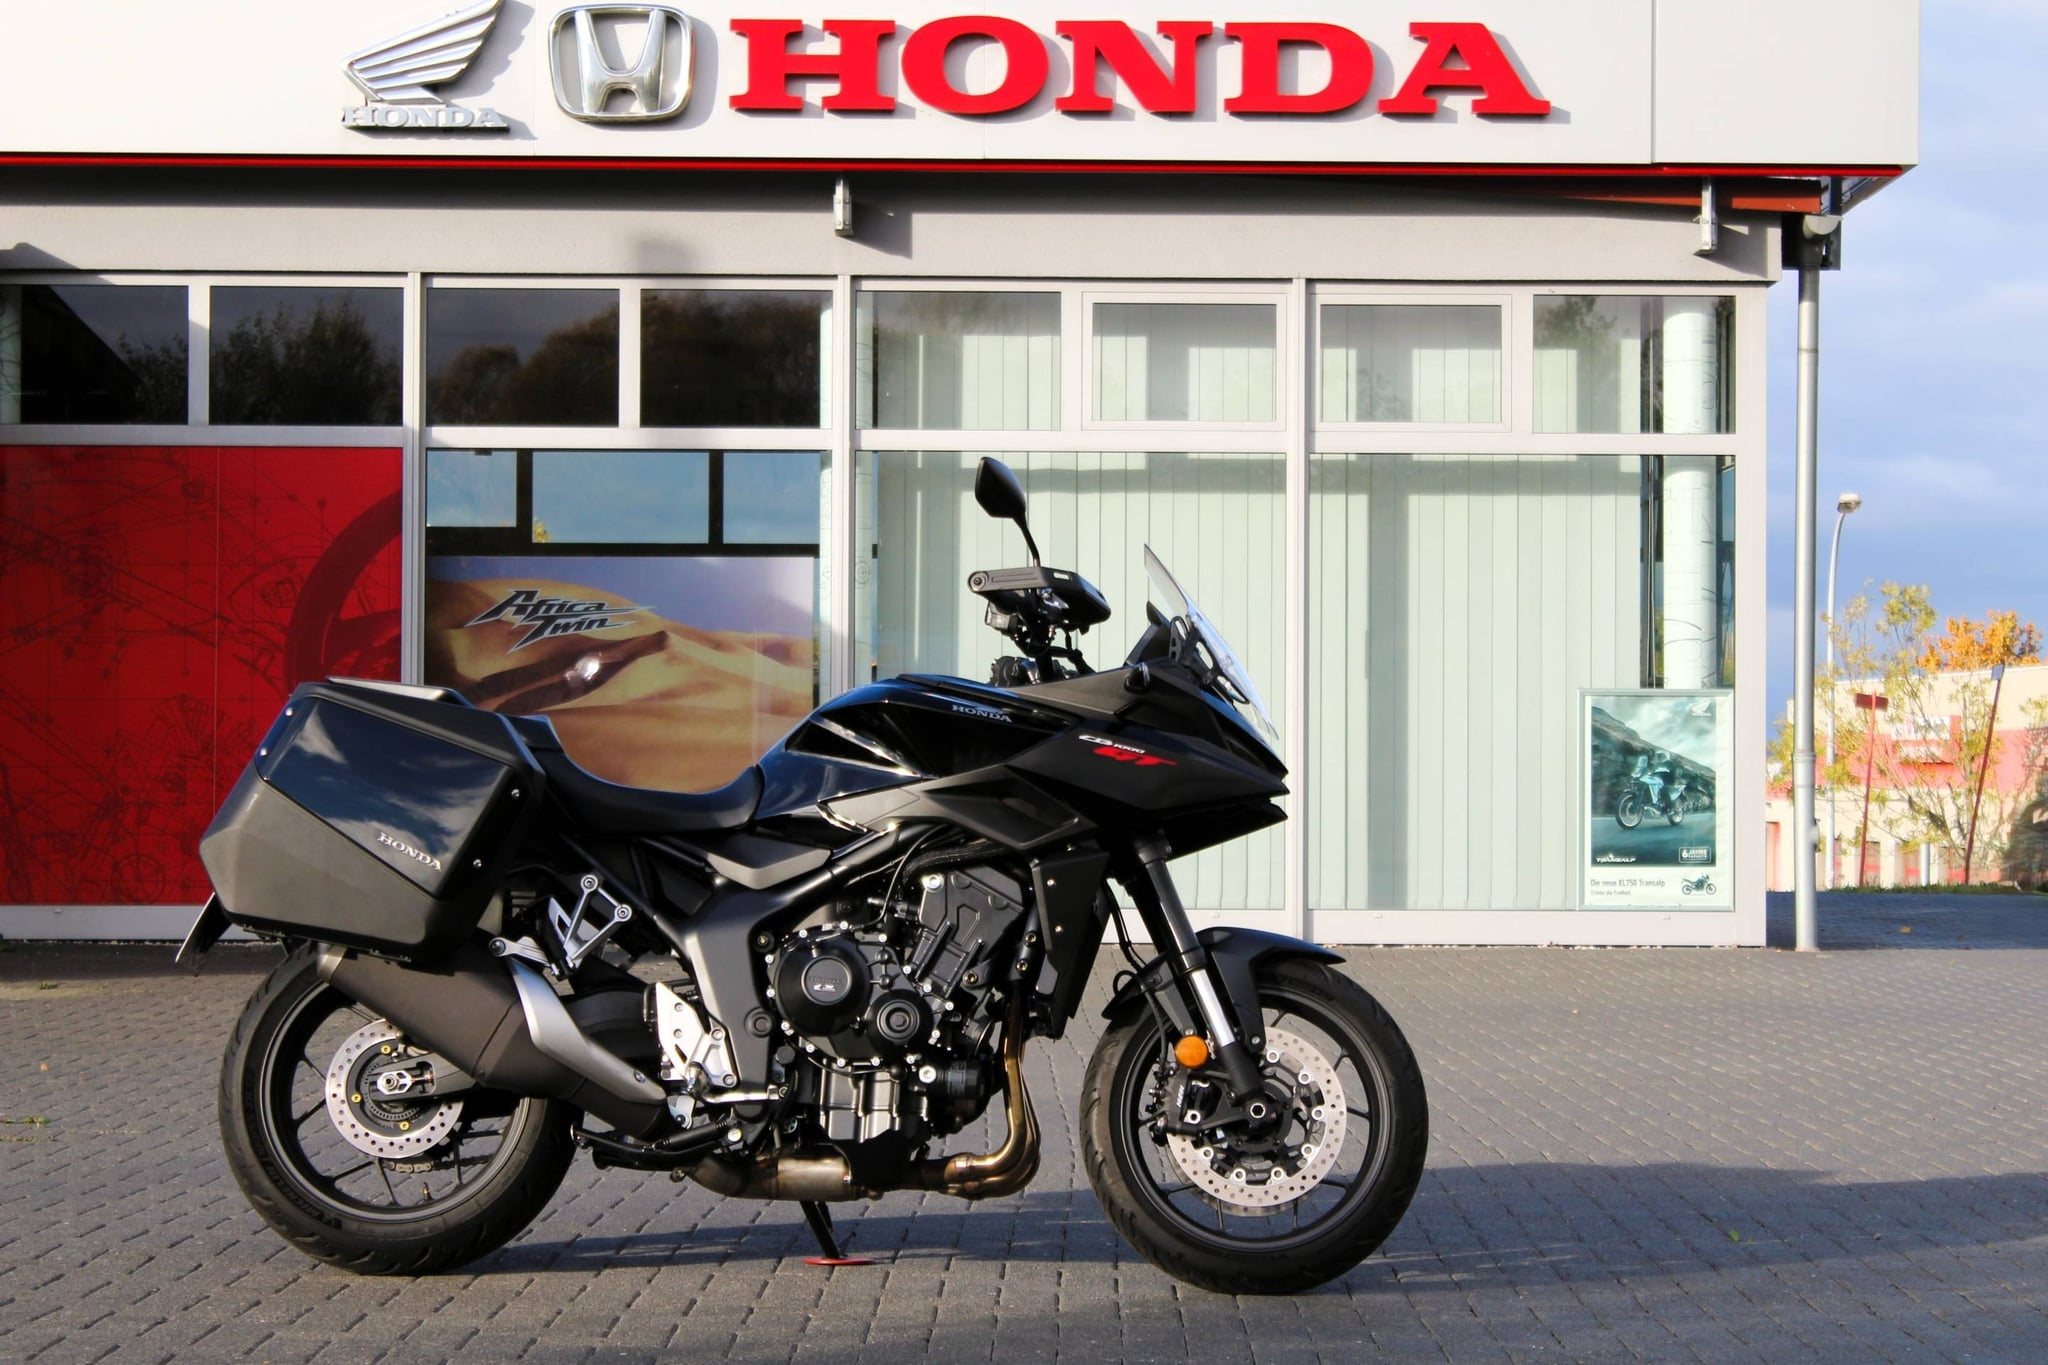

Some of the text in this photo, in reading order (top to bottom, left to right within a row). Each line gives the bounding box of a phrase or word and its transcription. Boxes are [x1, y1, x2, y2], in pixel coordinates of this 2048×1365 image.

[730, 15, 1550, 114] HONDA
[342, 106, 508, 128] HONDA
[464, 588, 656, 629] Africa
[506, 614, 637, 655] Twin
[951, 704, 1013, 723] HONDA
[376, 831, 442, 872] HONDA
[1681, 848, 1689, 858] 6
[1590, 879, 1601, 887] Die
[1639, 879, 1666, 889] Transalp
